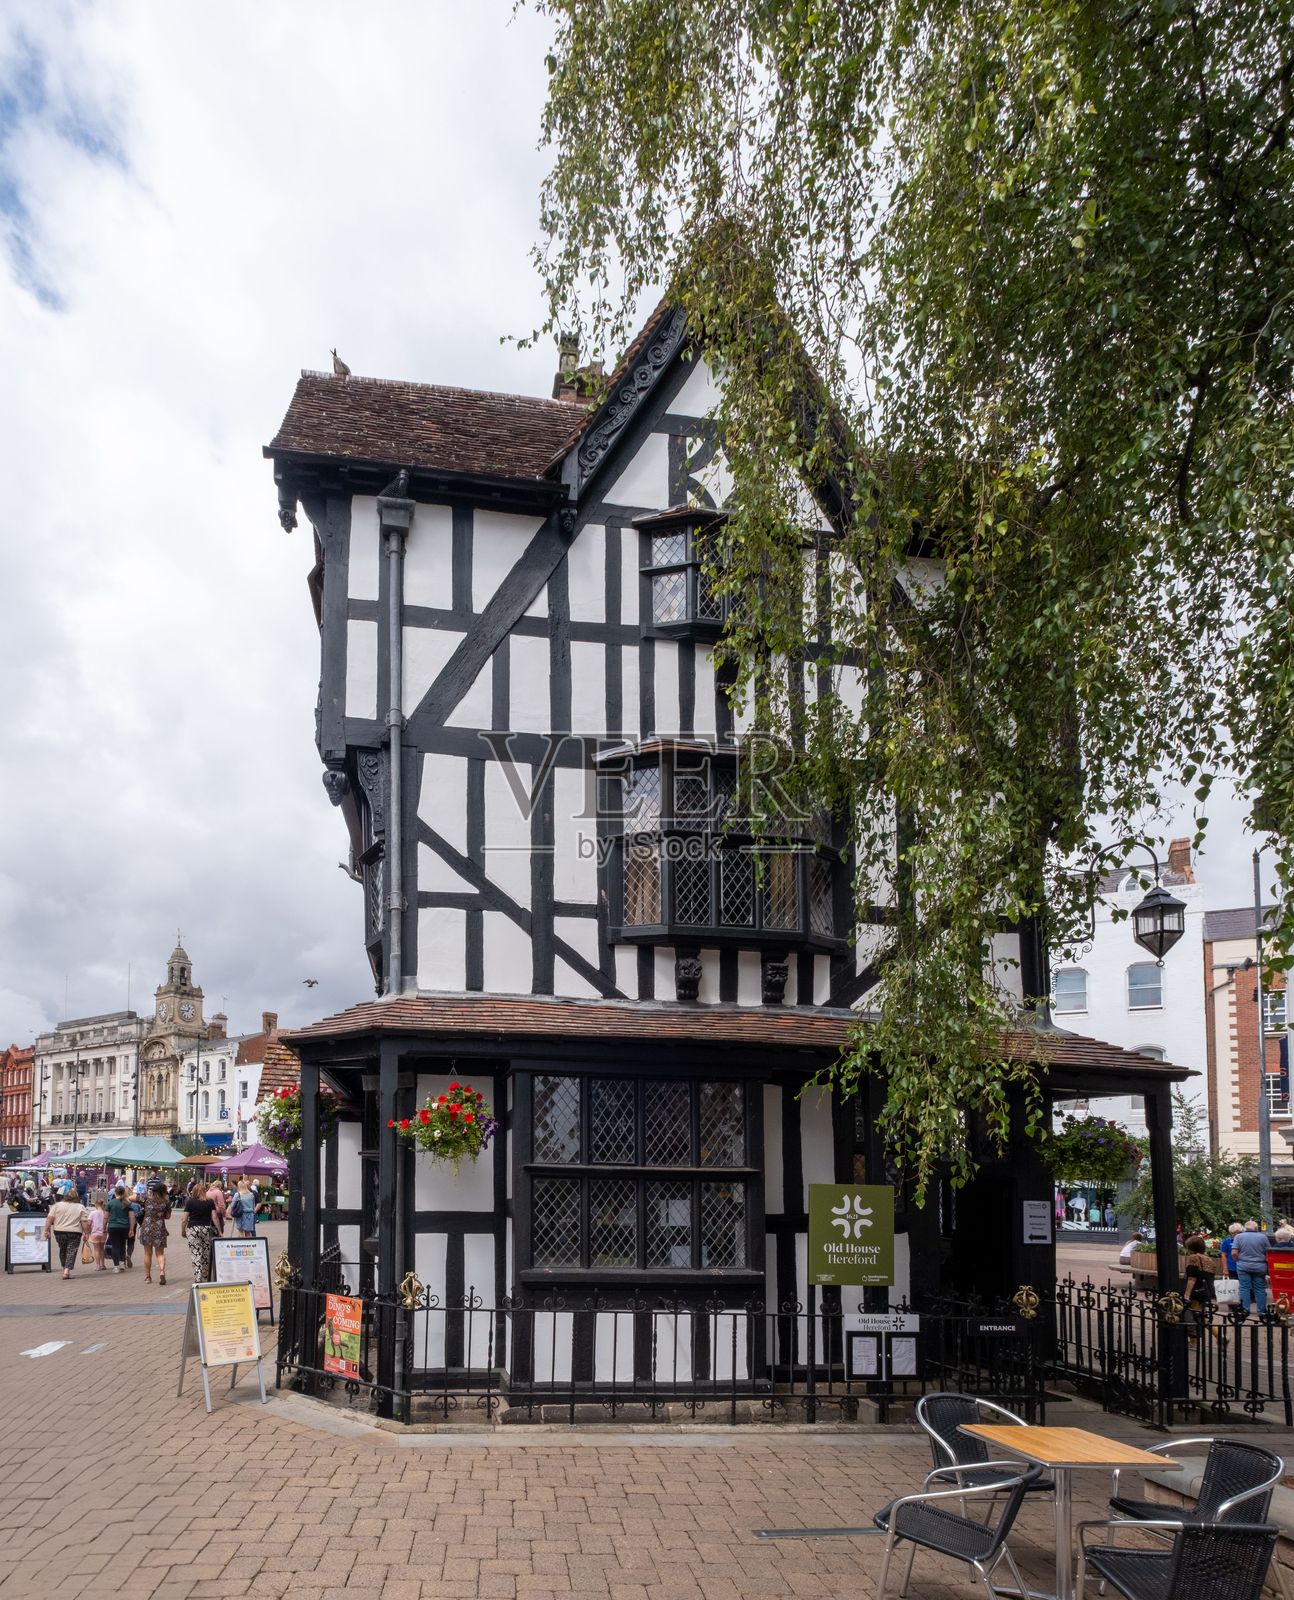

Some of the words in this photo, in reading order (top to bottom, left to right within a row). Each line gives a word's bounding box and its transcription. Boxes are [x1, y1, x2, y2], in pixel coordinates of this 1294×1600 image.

[823, 1243, 843, 1253] Old
[846, 1243, 881, 1253] House
[828, 1254, 876, 1265] Hereford
[328, 1301, 351, 1314] DINO'S
[333, 1315, 360, 1330] COMING
